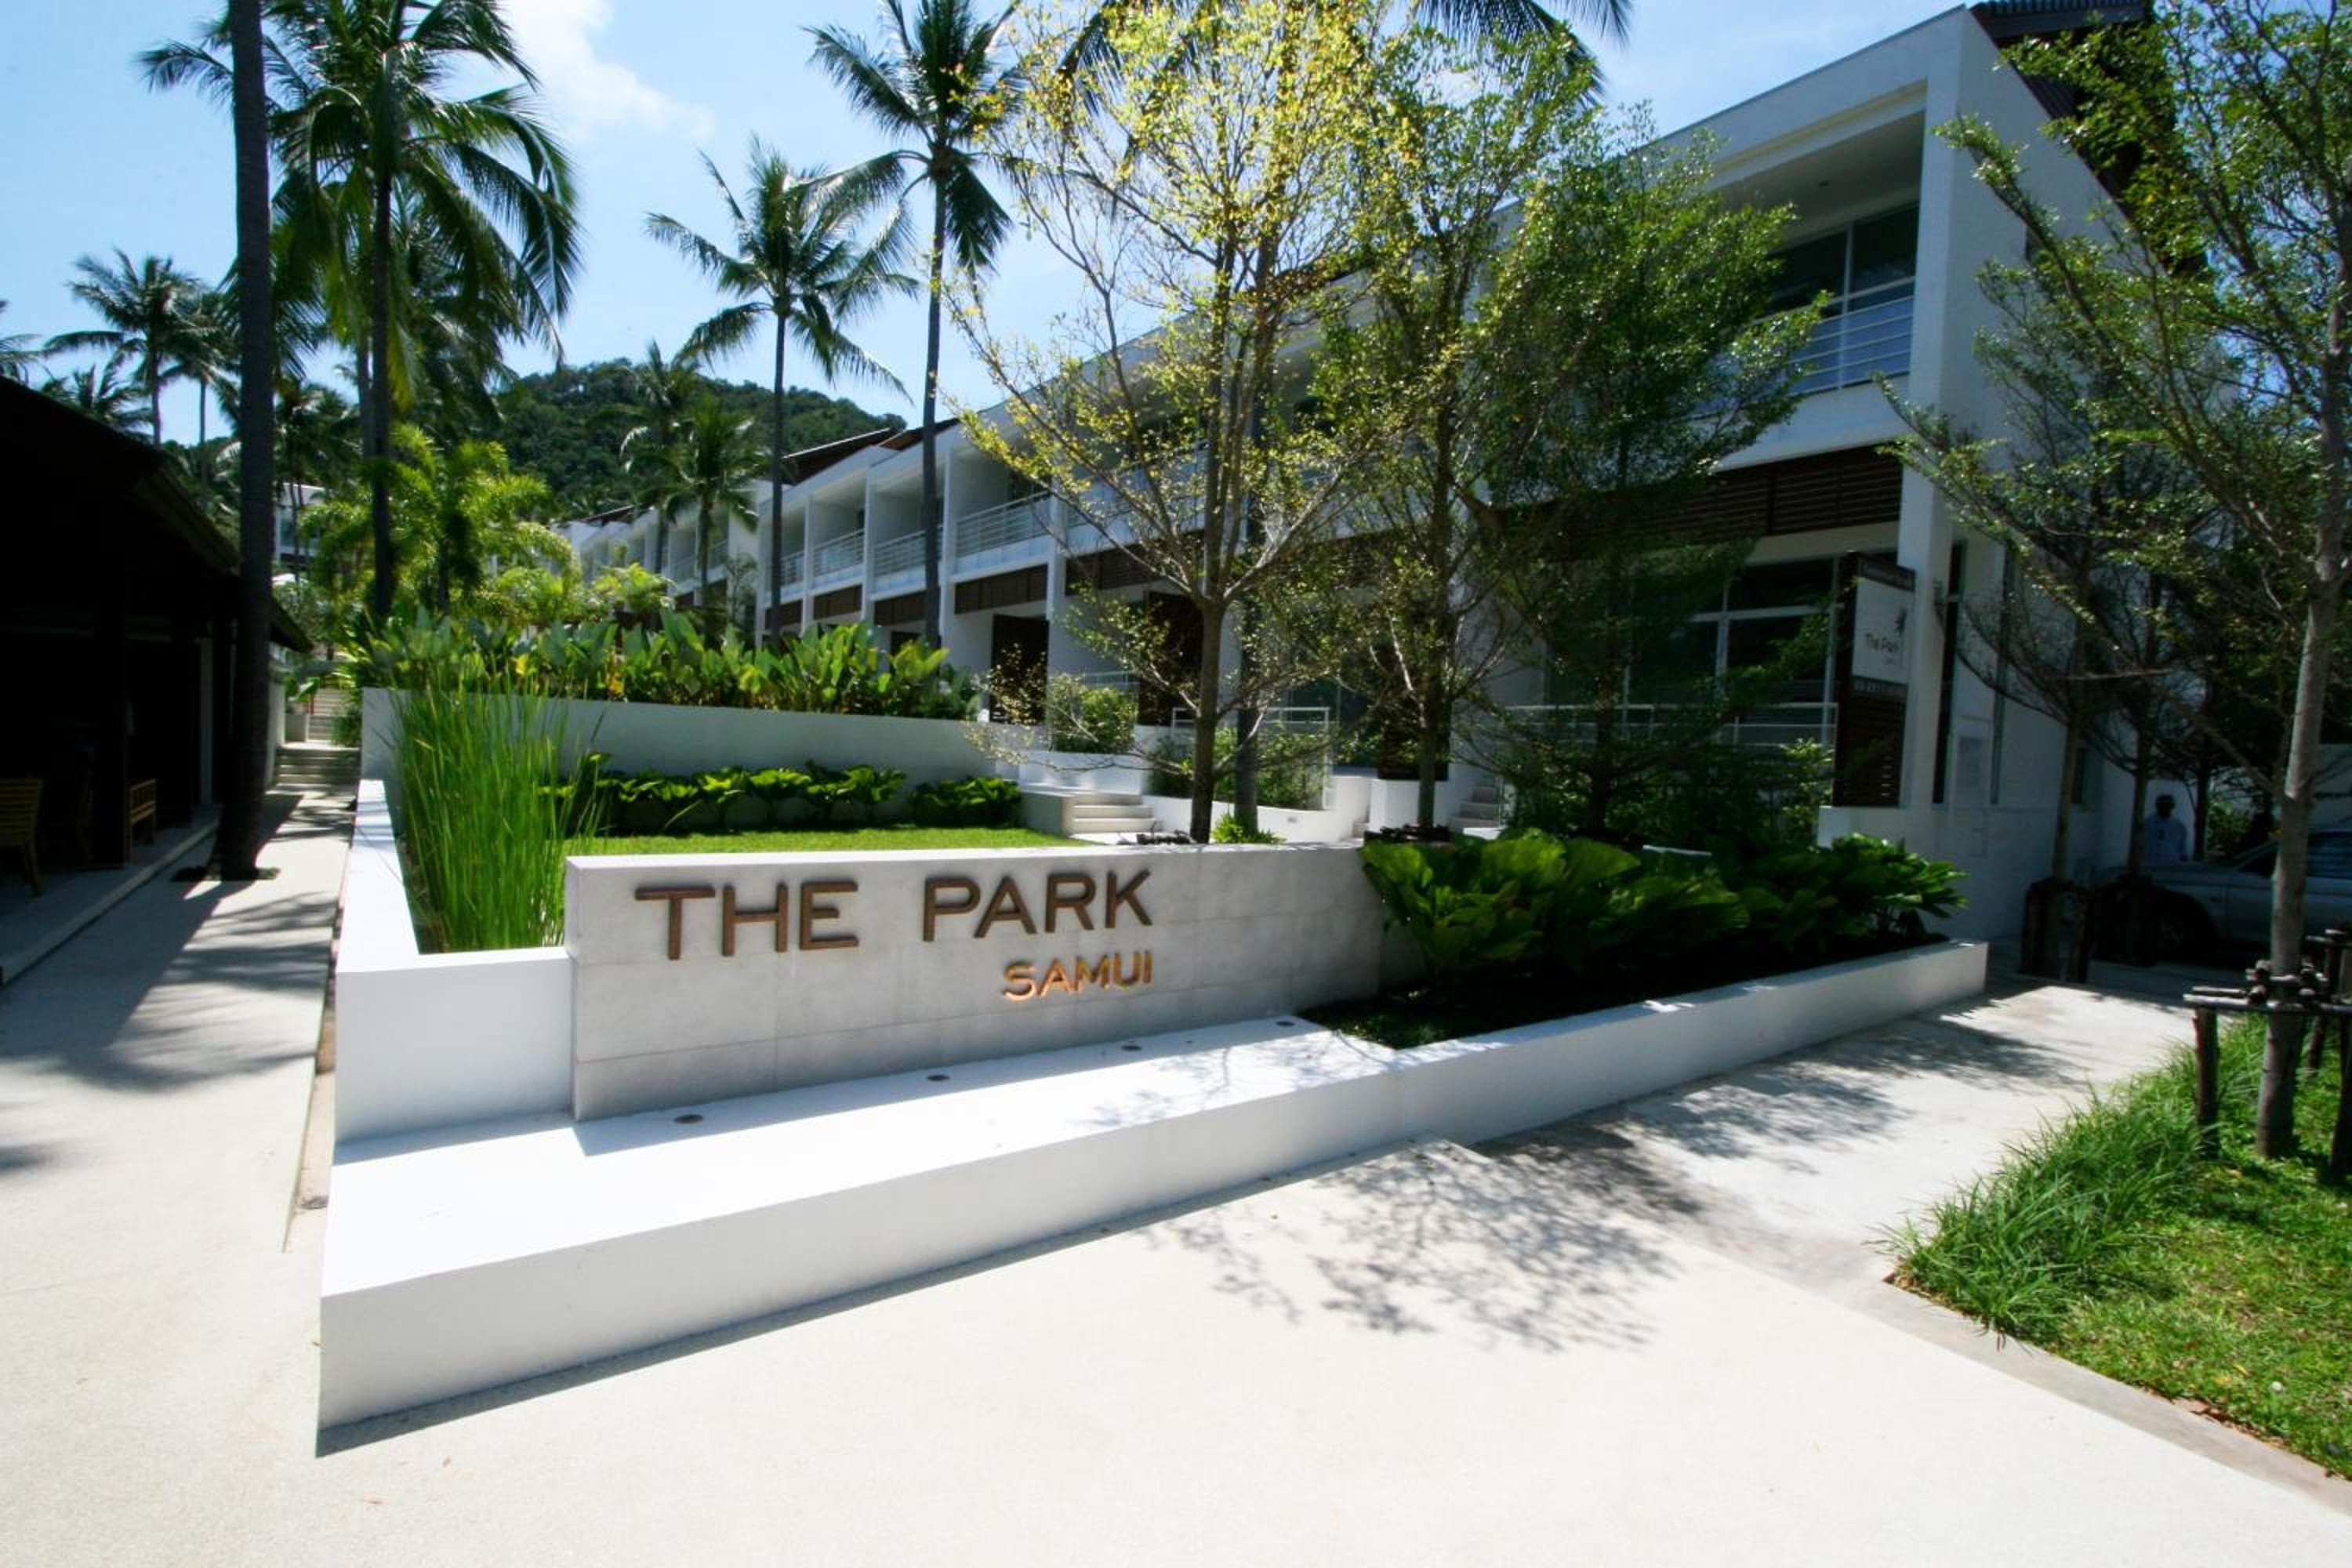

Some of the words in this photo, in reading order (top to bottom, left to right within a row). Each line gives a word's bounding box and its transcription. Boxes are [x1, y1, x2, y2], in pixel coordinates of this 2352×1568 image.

[636, 880, 859, 961] THE
[923, 869, 1152, 942] PARK
[1004, 950, 1153, 1001] SAMUI
